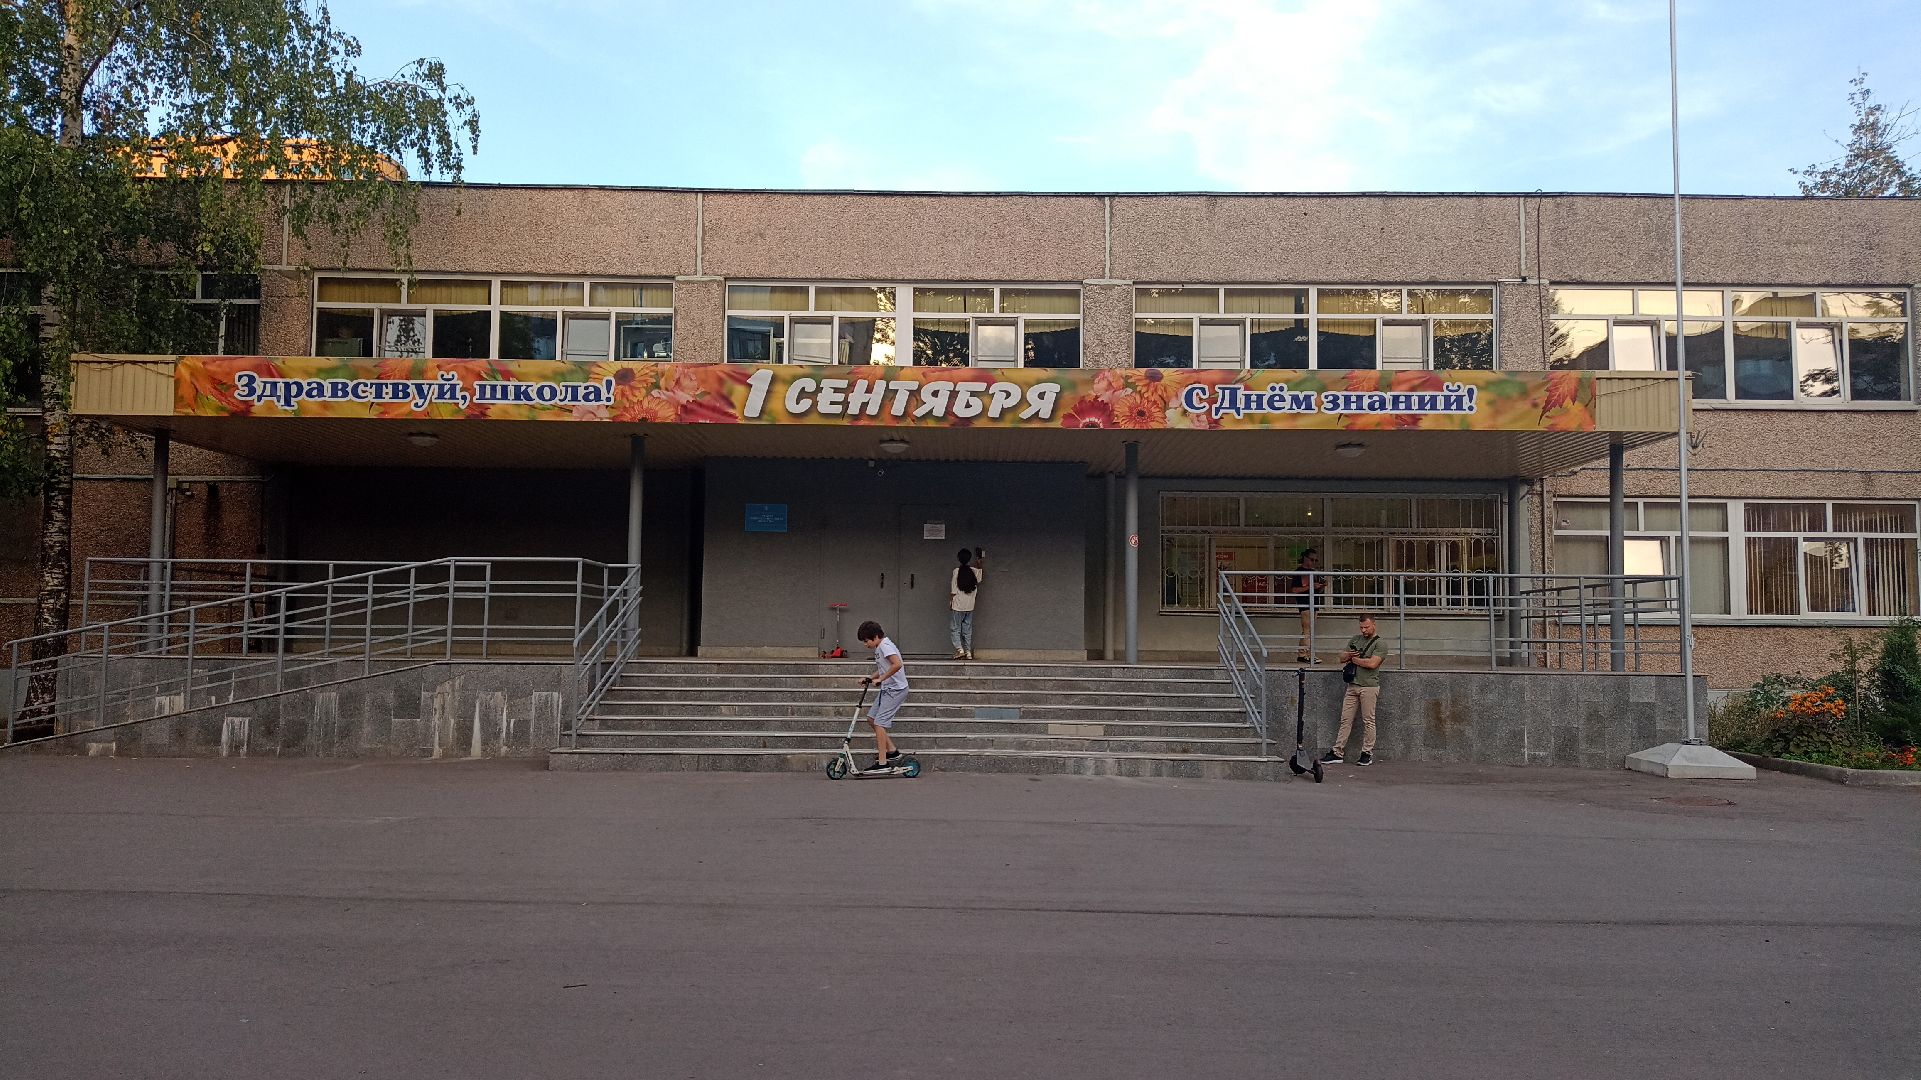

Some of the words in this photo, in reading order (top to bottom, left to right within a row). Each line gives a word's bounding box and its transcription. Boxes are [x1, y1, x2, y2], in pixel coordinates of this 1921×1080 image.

[236, 373, 468, 409] Здравствуй,
[475, 378, 614, 403] школа!
[743, 368, 774, 418] 1
[784, 377, 1061, 420] СЕНТЯБРЯ
[1183, 386, 1208, 411] С
[1214, 385, 1316, 417] Днём
[1323, 384, 1475, 412] знаний!
